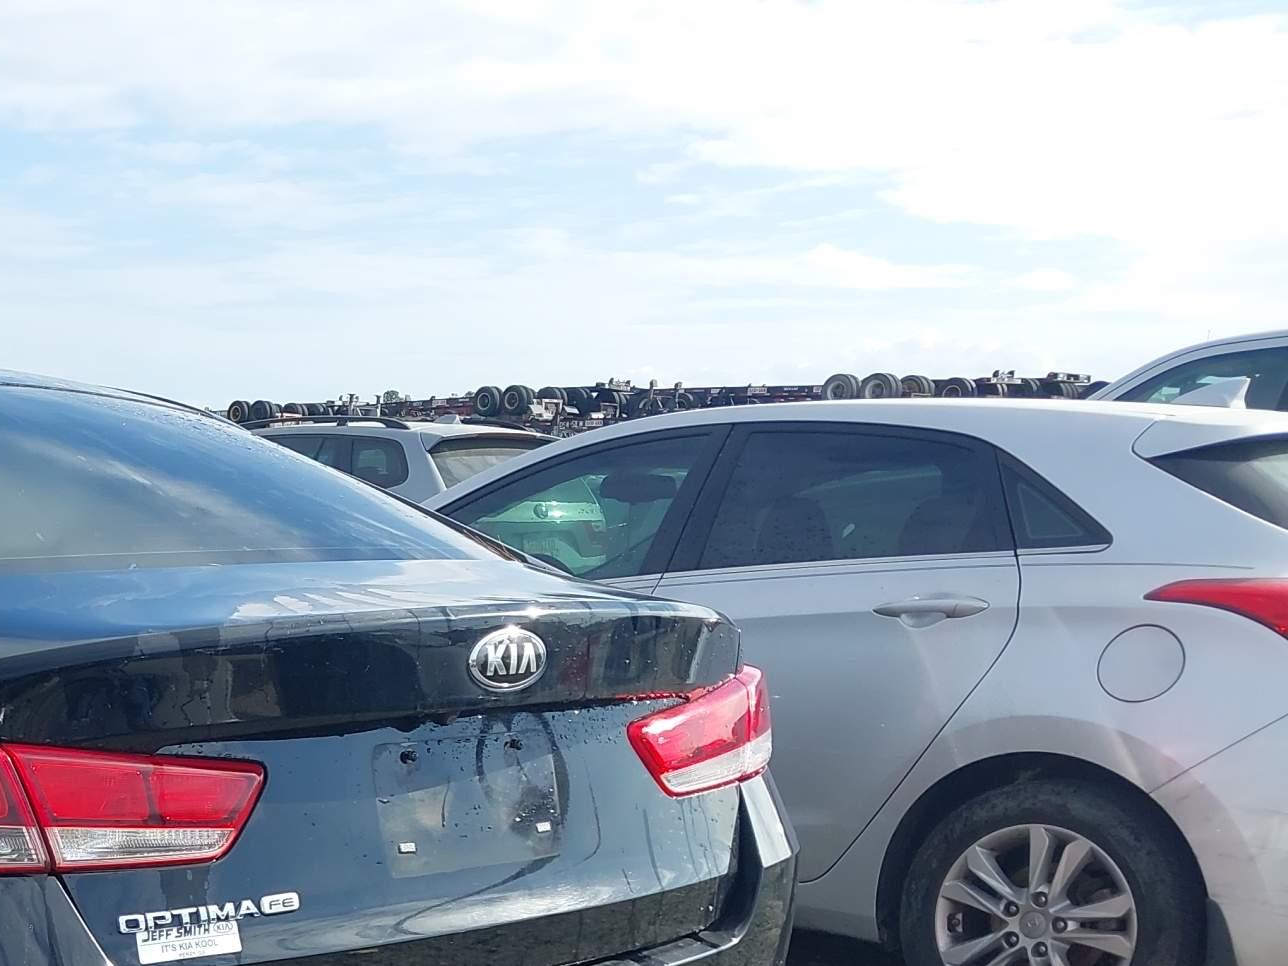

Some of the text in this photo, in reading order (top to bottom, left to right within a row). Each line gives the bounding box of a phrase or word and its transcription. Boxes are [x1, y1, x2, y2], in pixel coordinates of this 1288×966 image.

[485, 637, 537, 676] KIA
[118, 899, 261, 934] OPTIMA
[142, 928, 173, 943] JEFF
[175, 924, 210, 939] SMITH
[161, 939, 219, 953] IT'S KIA KOOL
